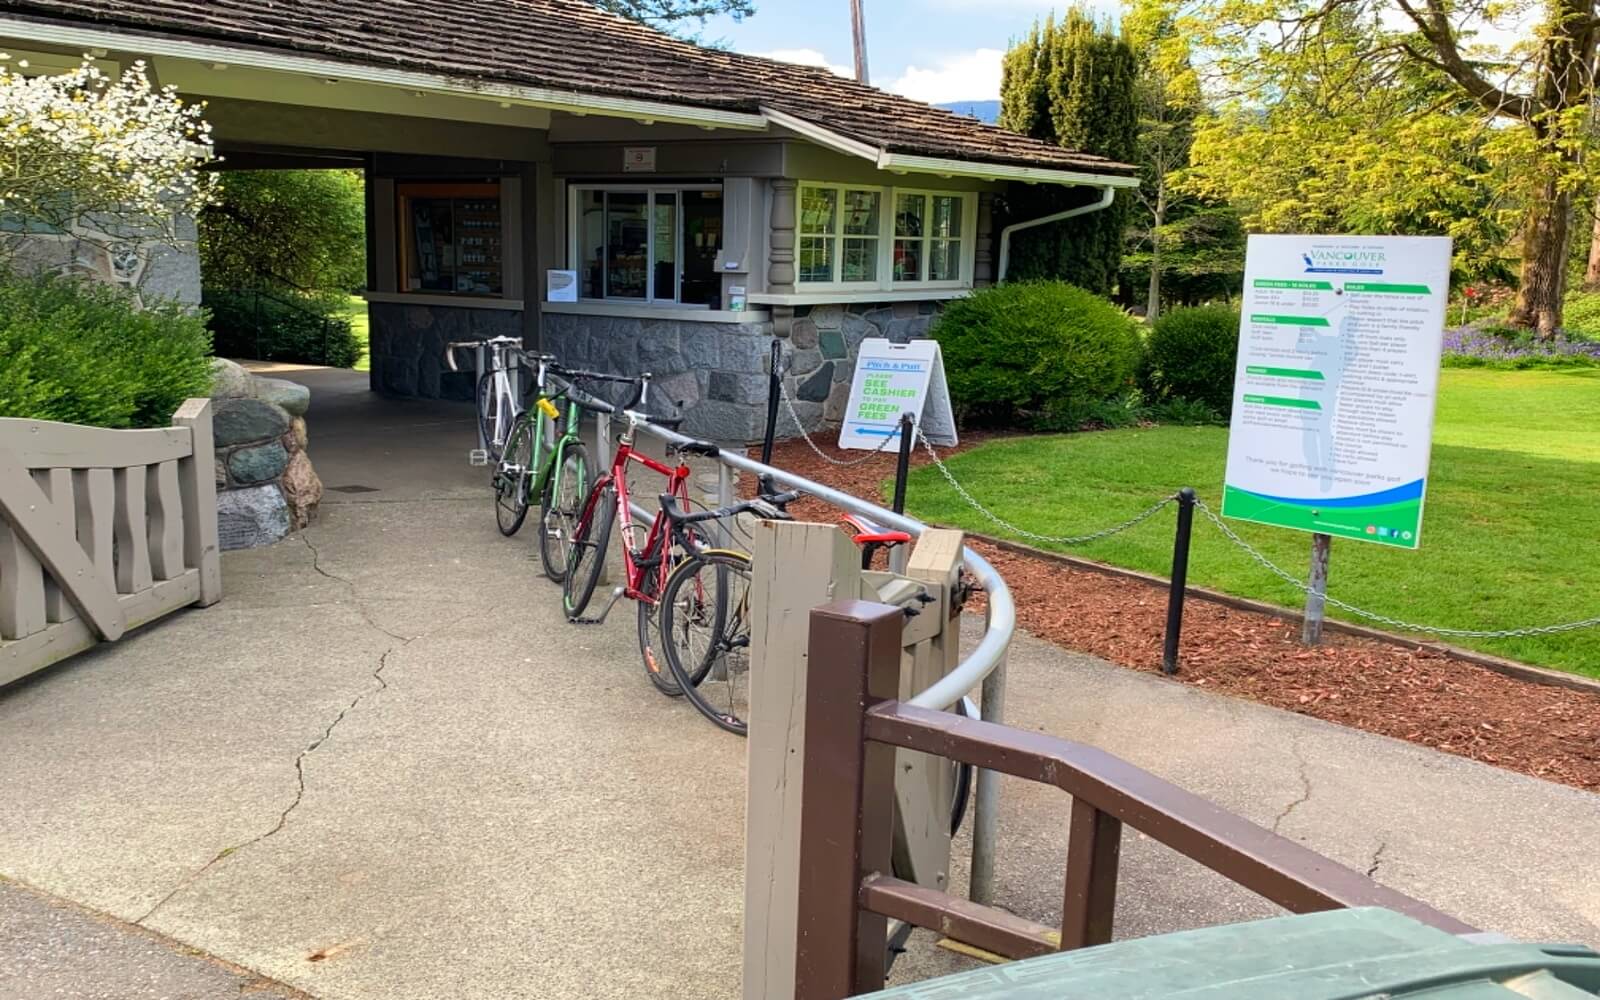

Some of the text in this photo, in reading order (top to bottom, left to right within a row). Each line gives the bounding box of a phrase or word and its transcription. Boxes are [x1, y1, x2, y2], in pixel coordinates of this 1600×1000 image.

[1310, 250, 1386, 261] VANCOUVER
[867, 360, 890, 369] Pitch
[864, 379, 888, 388] SEE
[864, 388, 917, 398] CASHIER
[859, 402, 900, 412] GREEN
[858, 411, 888, 420] FEES
